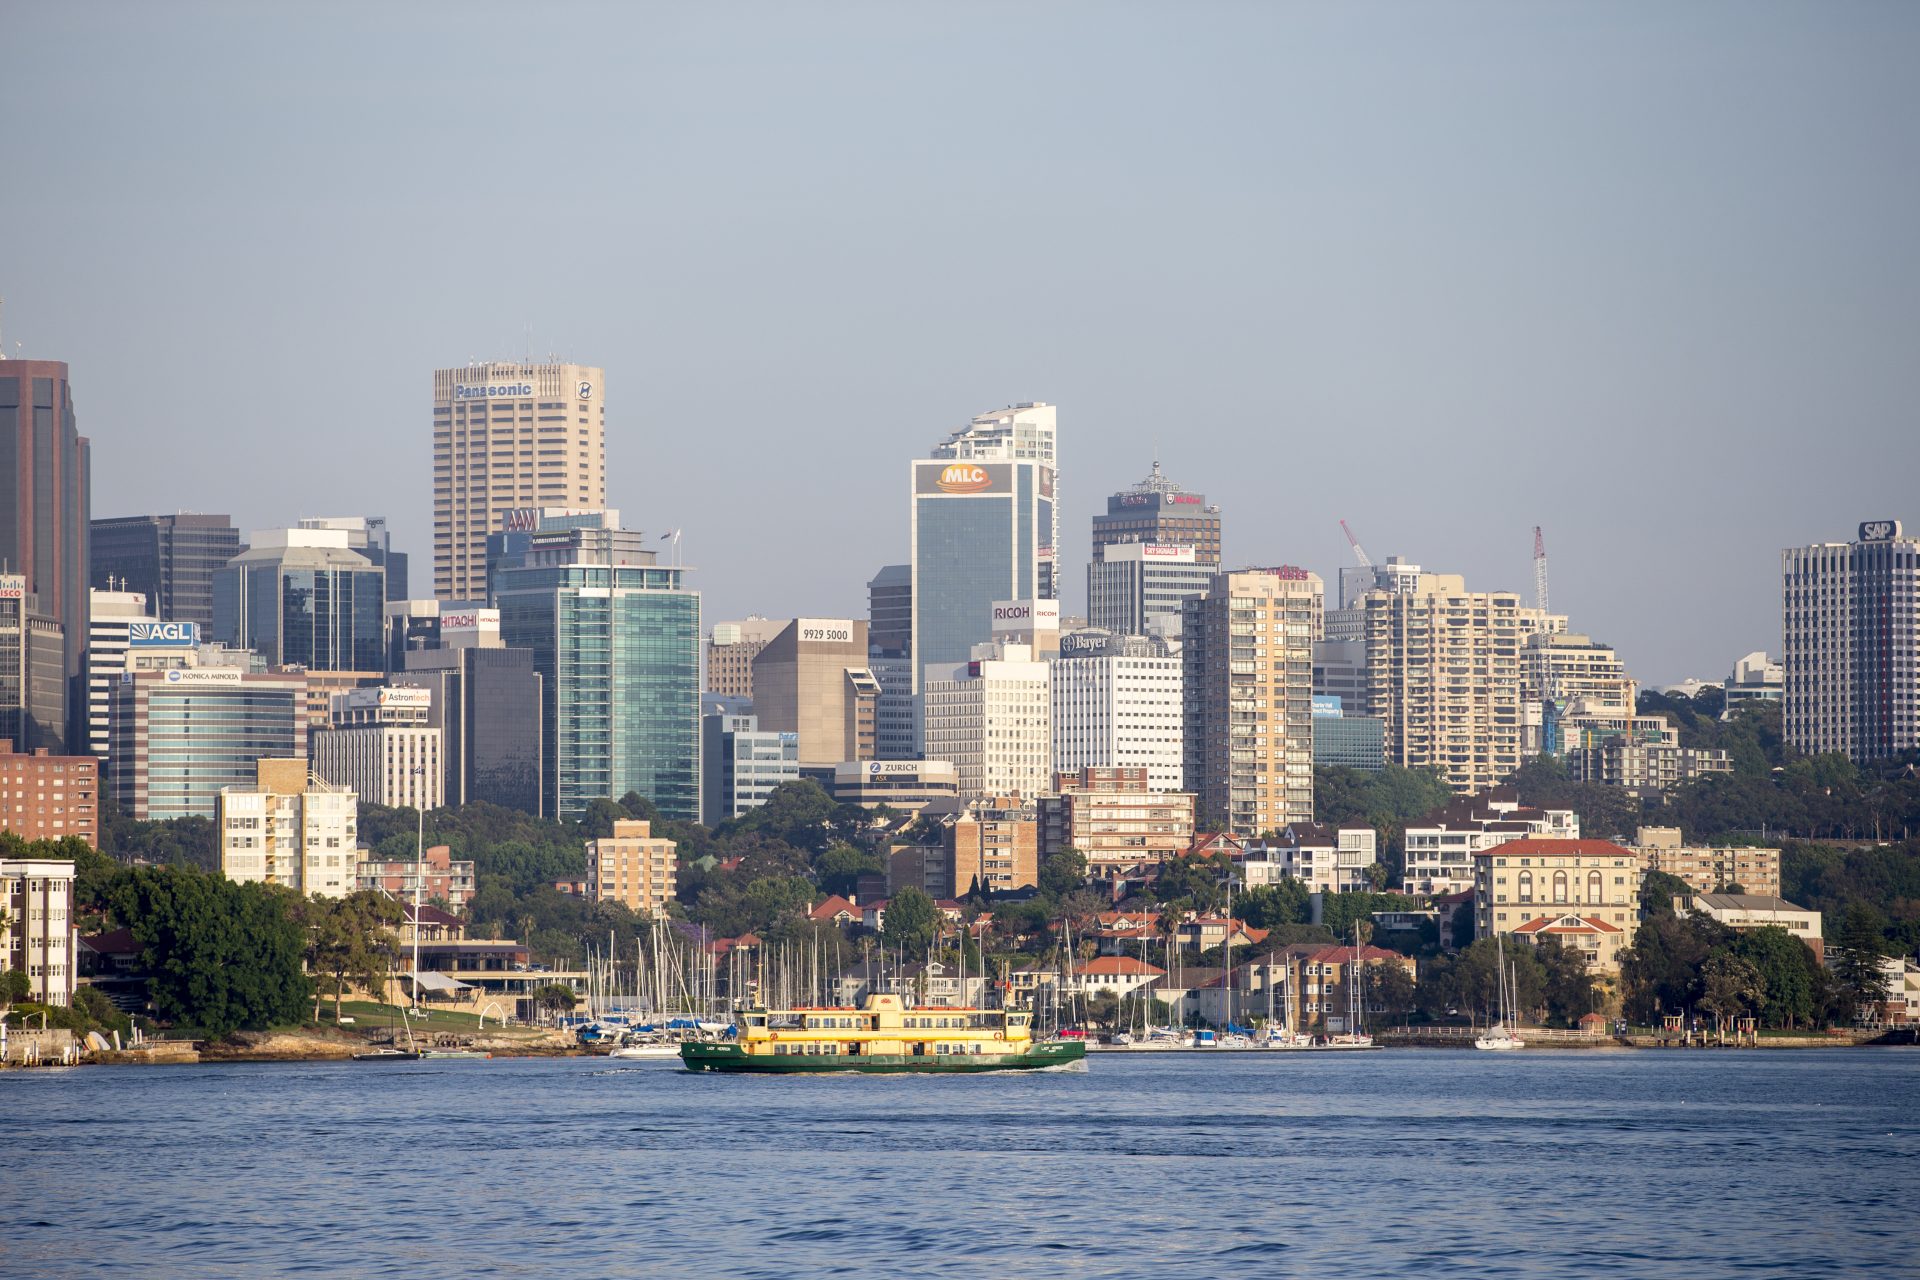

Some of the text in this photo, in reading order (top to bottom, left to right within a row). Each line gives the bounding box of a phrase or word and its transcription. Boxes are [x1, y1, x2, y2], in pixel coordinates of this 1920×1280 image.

[456, 383, 531, 398] Panasonic
[946, 468, 983, 482] MLC
[1865, 523, 1890, 540] SAP
[995, 607, 1030, 619] RICOH
[442, 614, 476, 628] HITACHI
[150, 624, 190, 639] AGL
[804, 629, 848, 640] 9929 5000
[1076, 635, 1107, 652] Bayer
